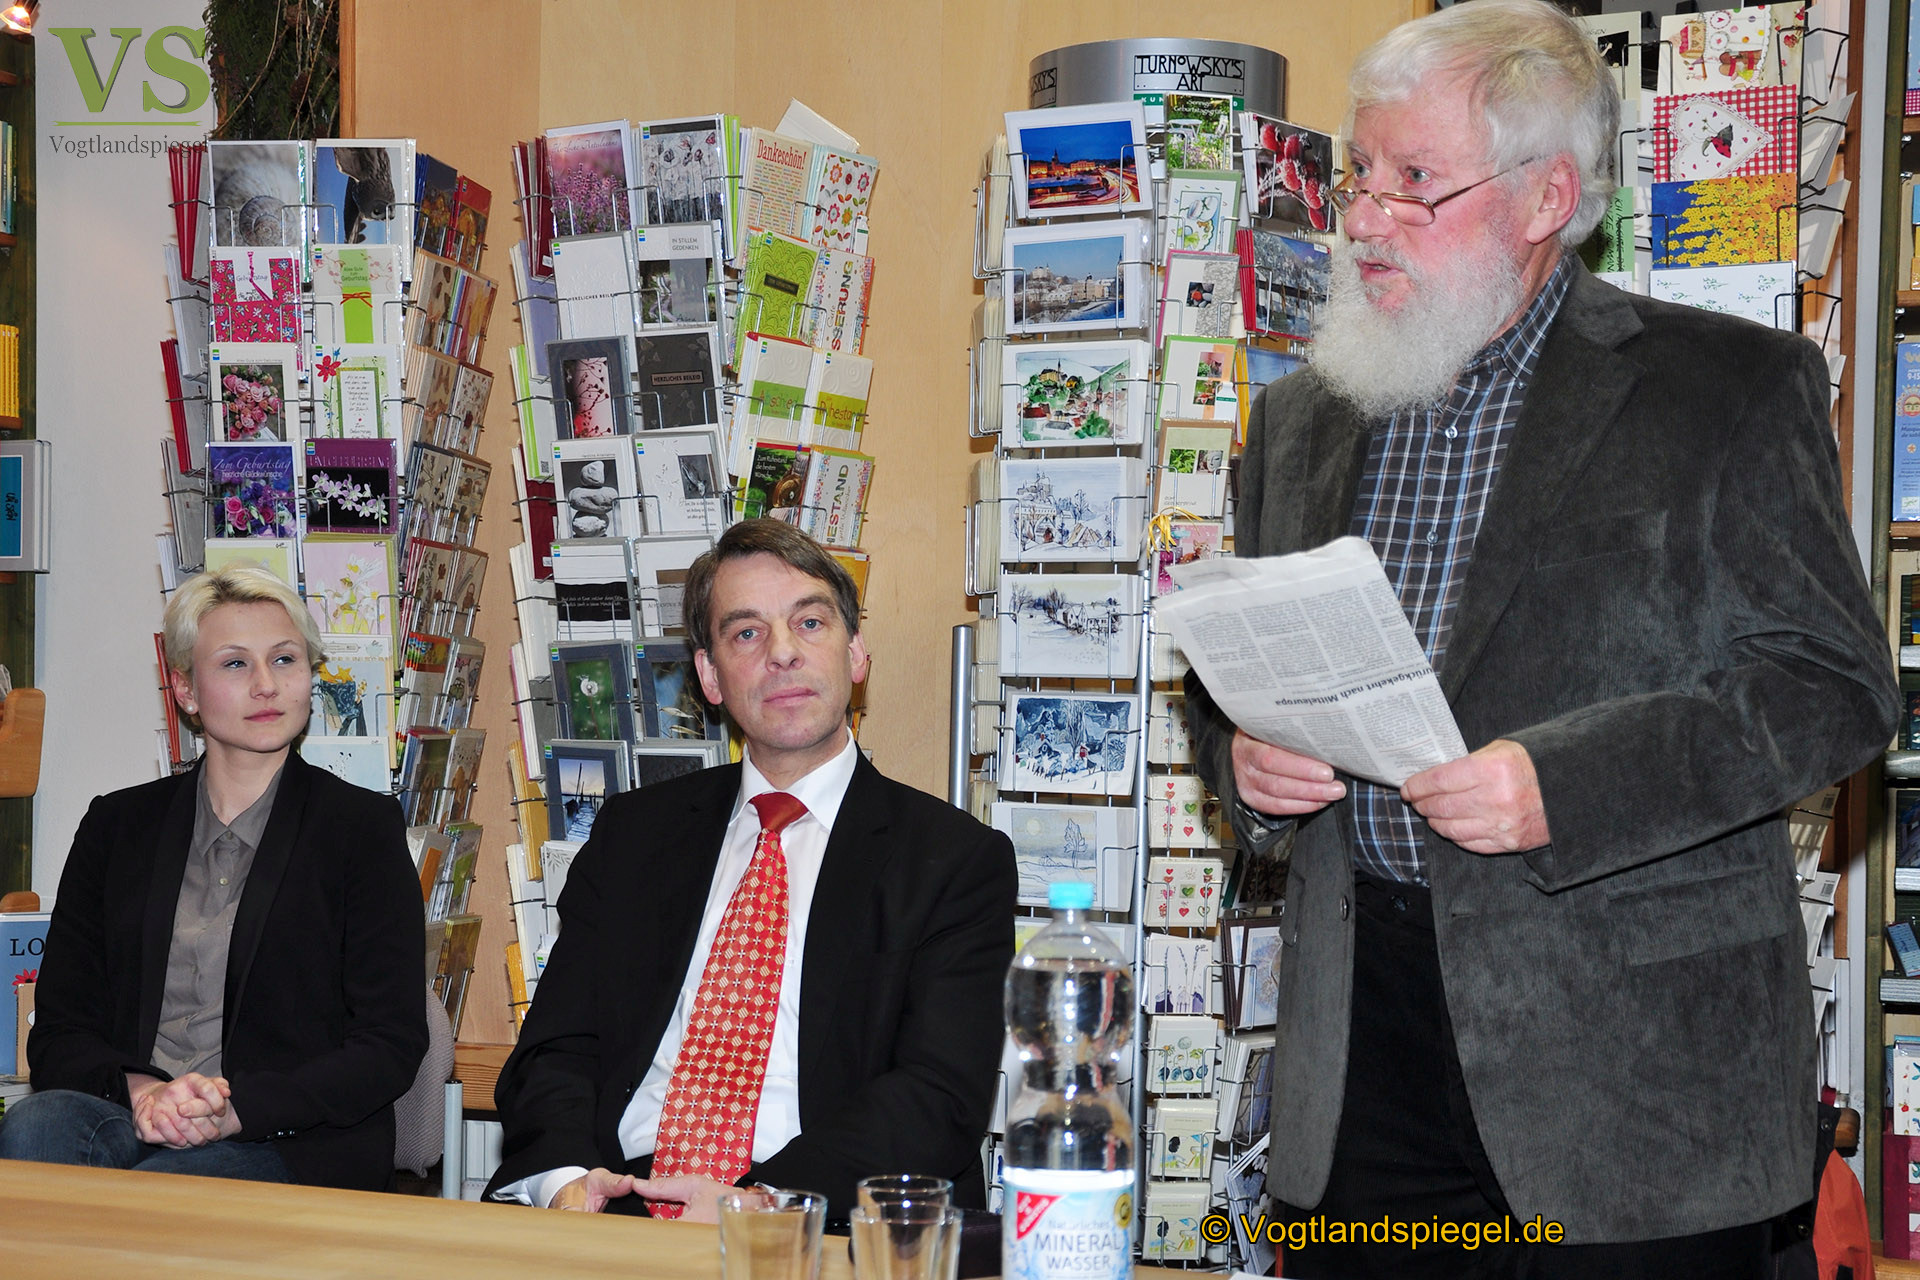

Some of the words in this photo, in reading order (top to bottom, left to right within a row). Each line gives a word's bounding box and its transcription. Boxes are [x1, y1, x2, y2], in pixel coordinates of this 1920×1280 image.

[1136, 55, 1243, 78] TURNOWSKY'S
[1176, 73, 1206, 91] ART
[756, 138, 807, 170] Dankeschön!
[213, 457, 235, 471] Zum
[236, 452, 292, 474] Geburtstag
[1275, 694, 1339, 707] Mitteleuropa
[1339, 686, 1364, 700] nach
[1034, 1231, 1122, 1253] MINERAL
[1045, 1255, 1111, 1271] WASSER
